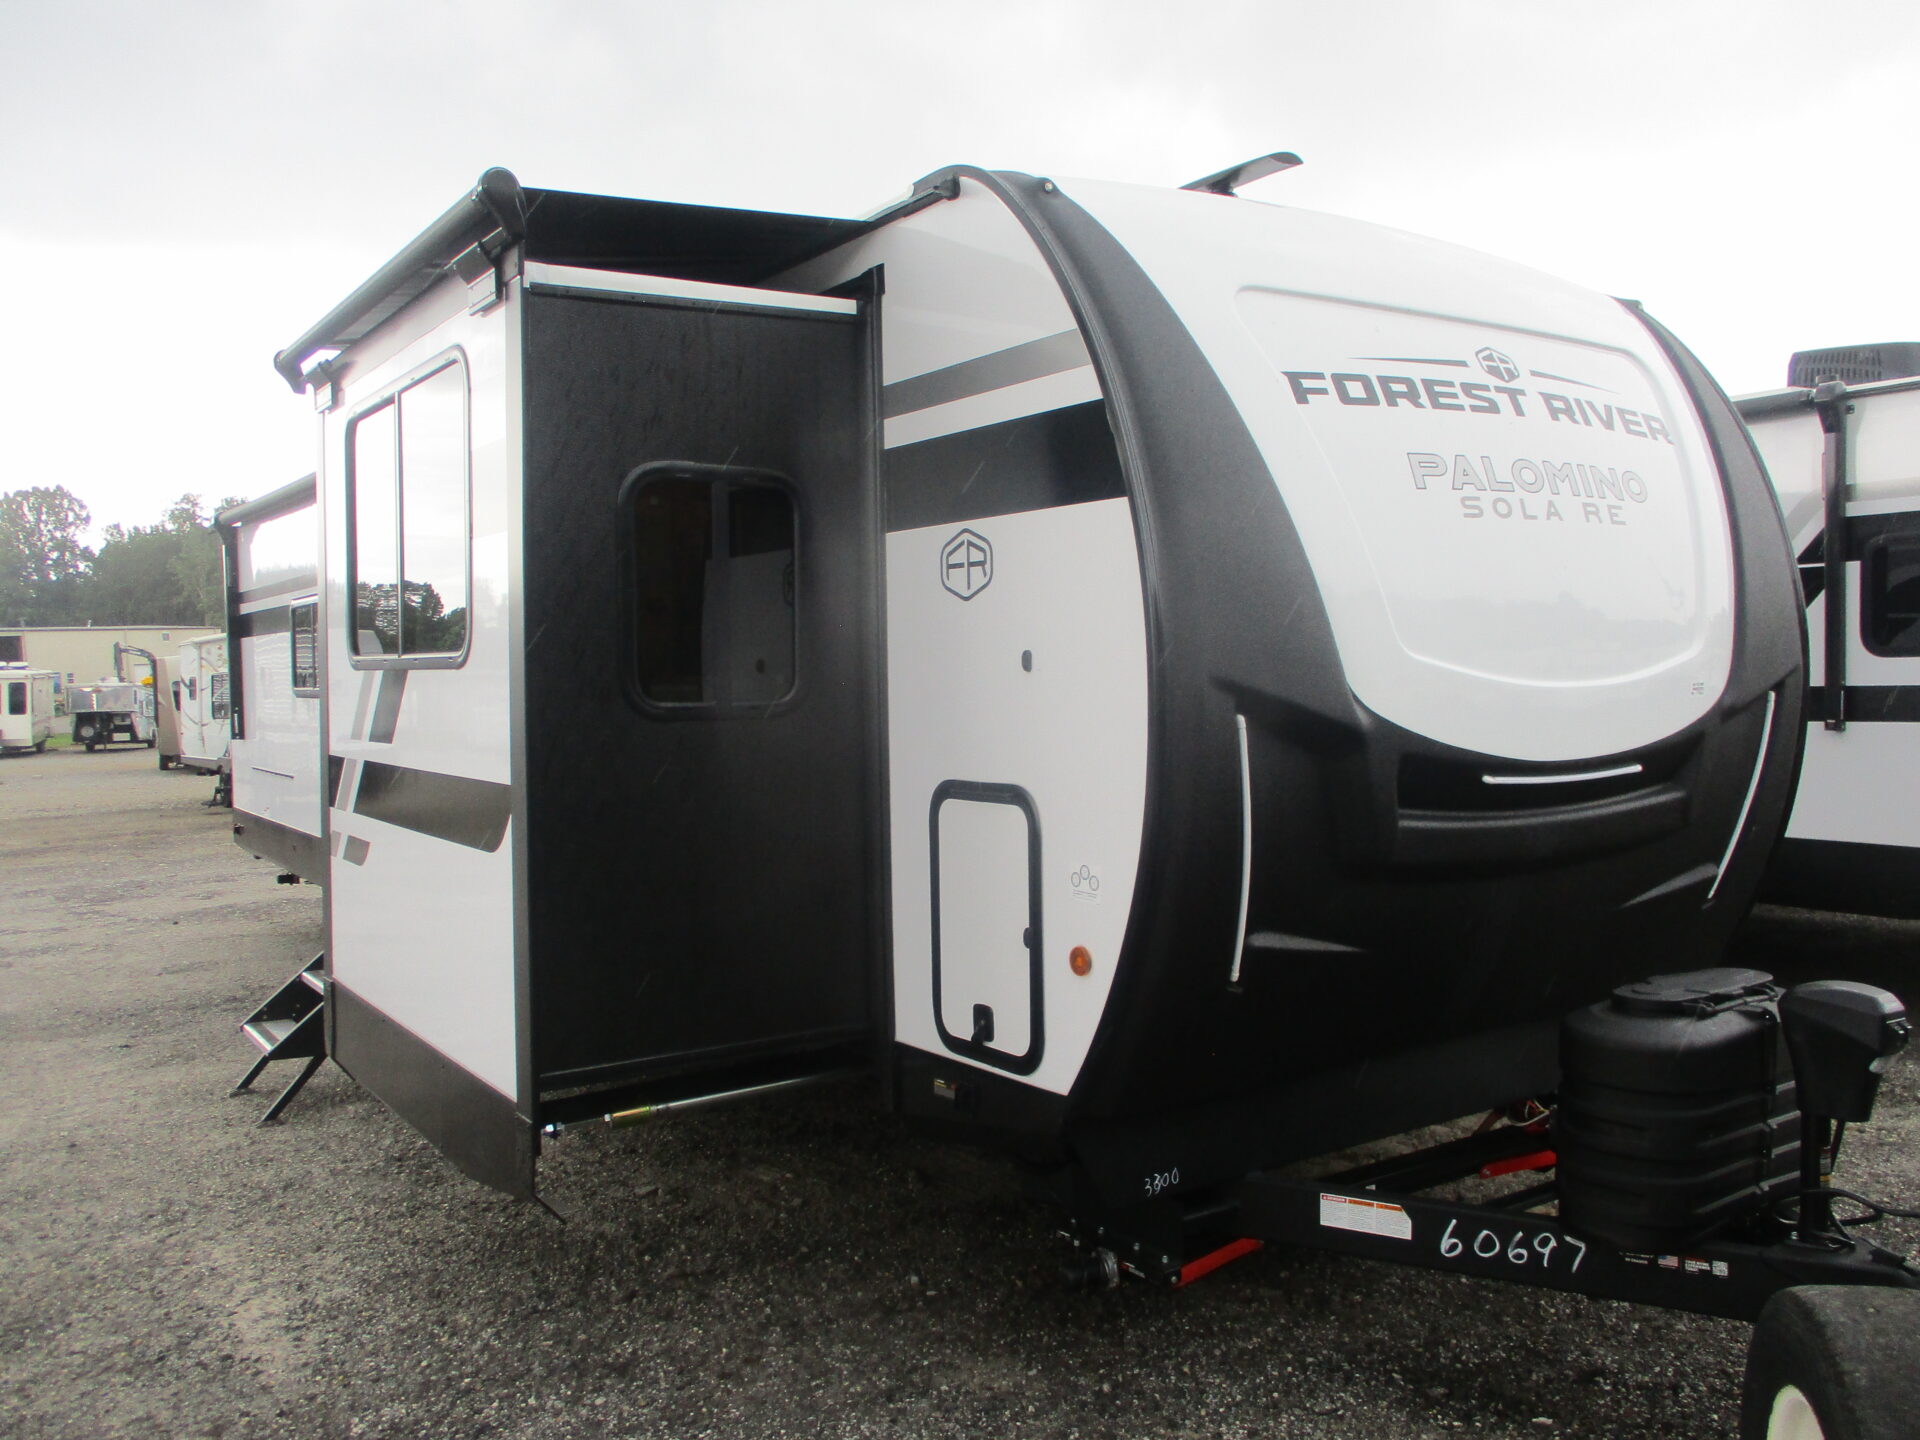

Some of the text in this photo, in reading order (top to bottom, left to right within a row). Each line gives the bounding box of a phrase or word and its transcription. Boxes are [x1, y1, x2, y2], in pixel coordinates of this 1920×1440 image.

[1281, 370, 1676, 445] FOREST RIVER
[1406, 452, 1649, 504] PALOMINO
[1440, 1218, 1586, 1274] 60697
